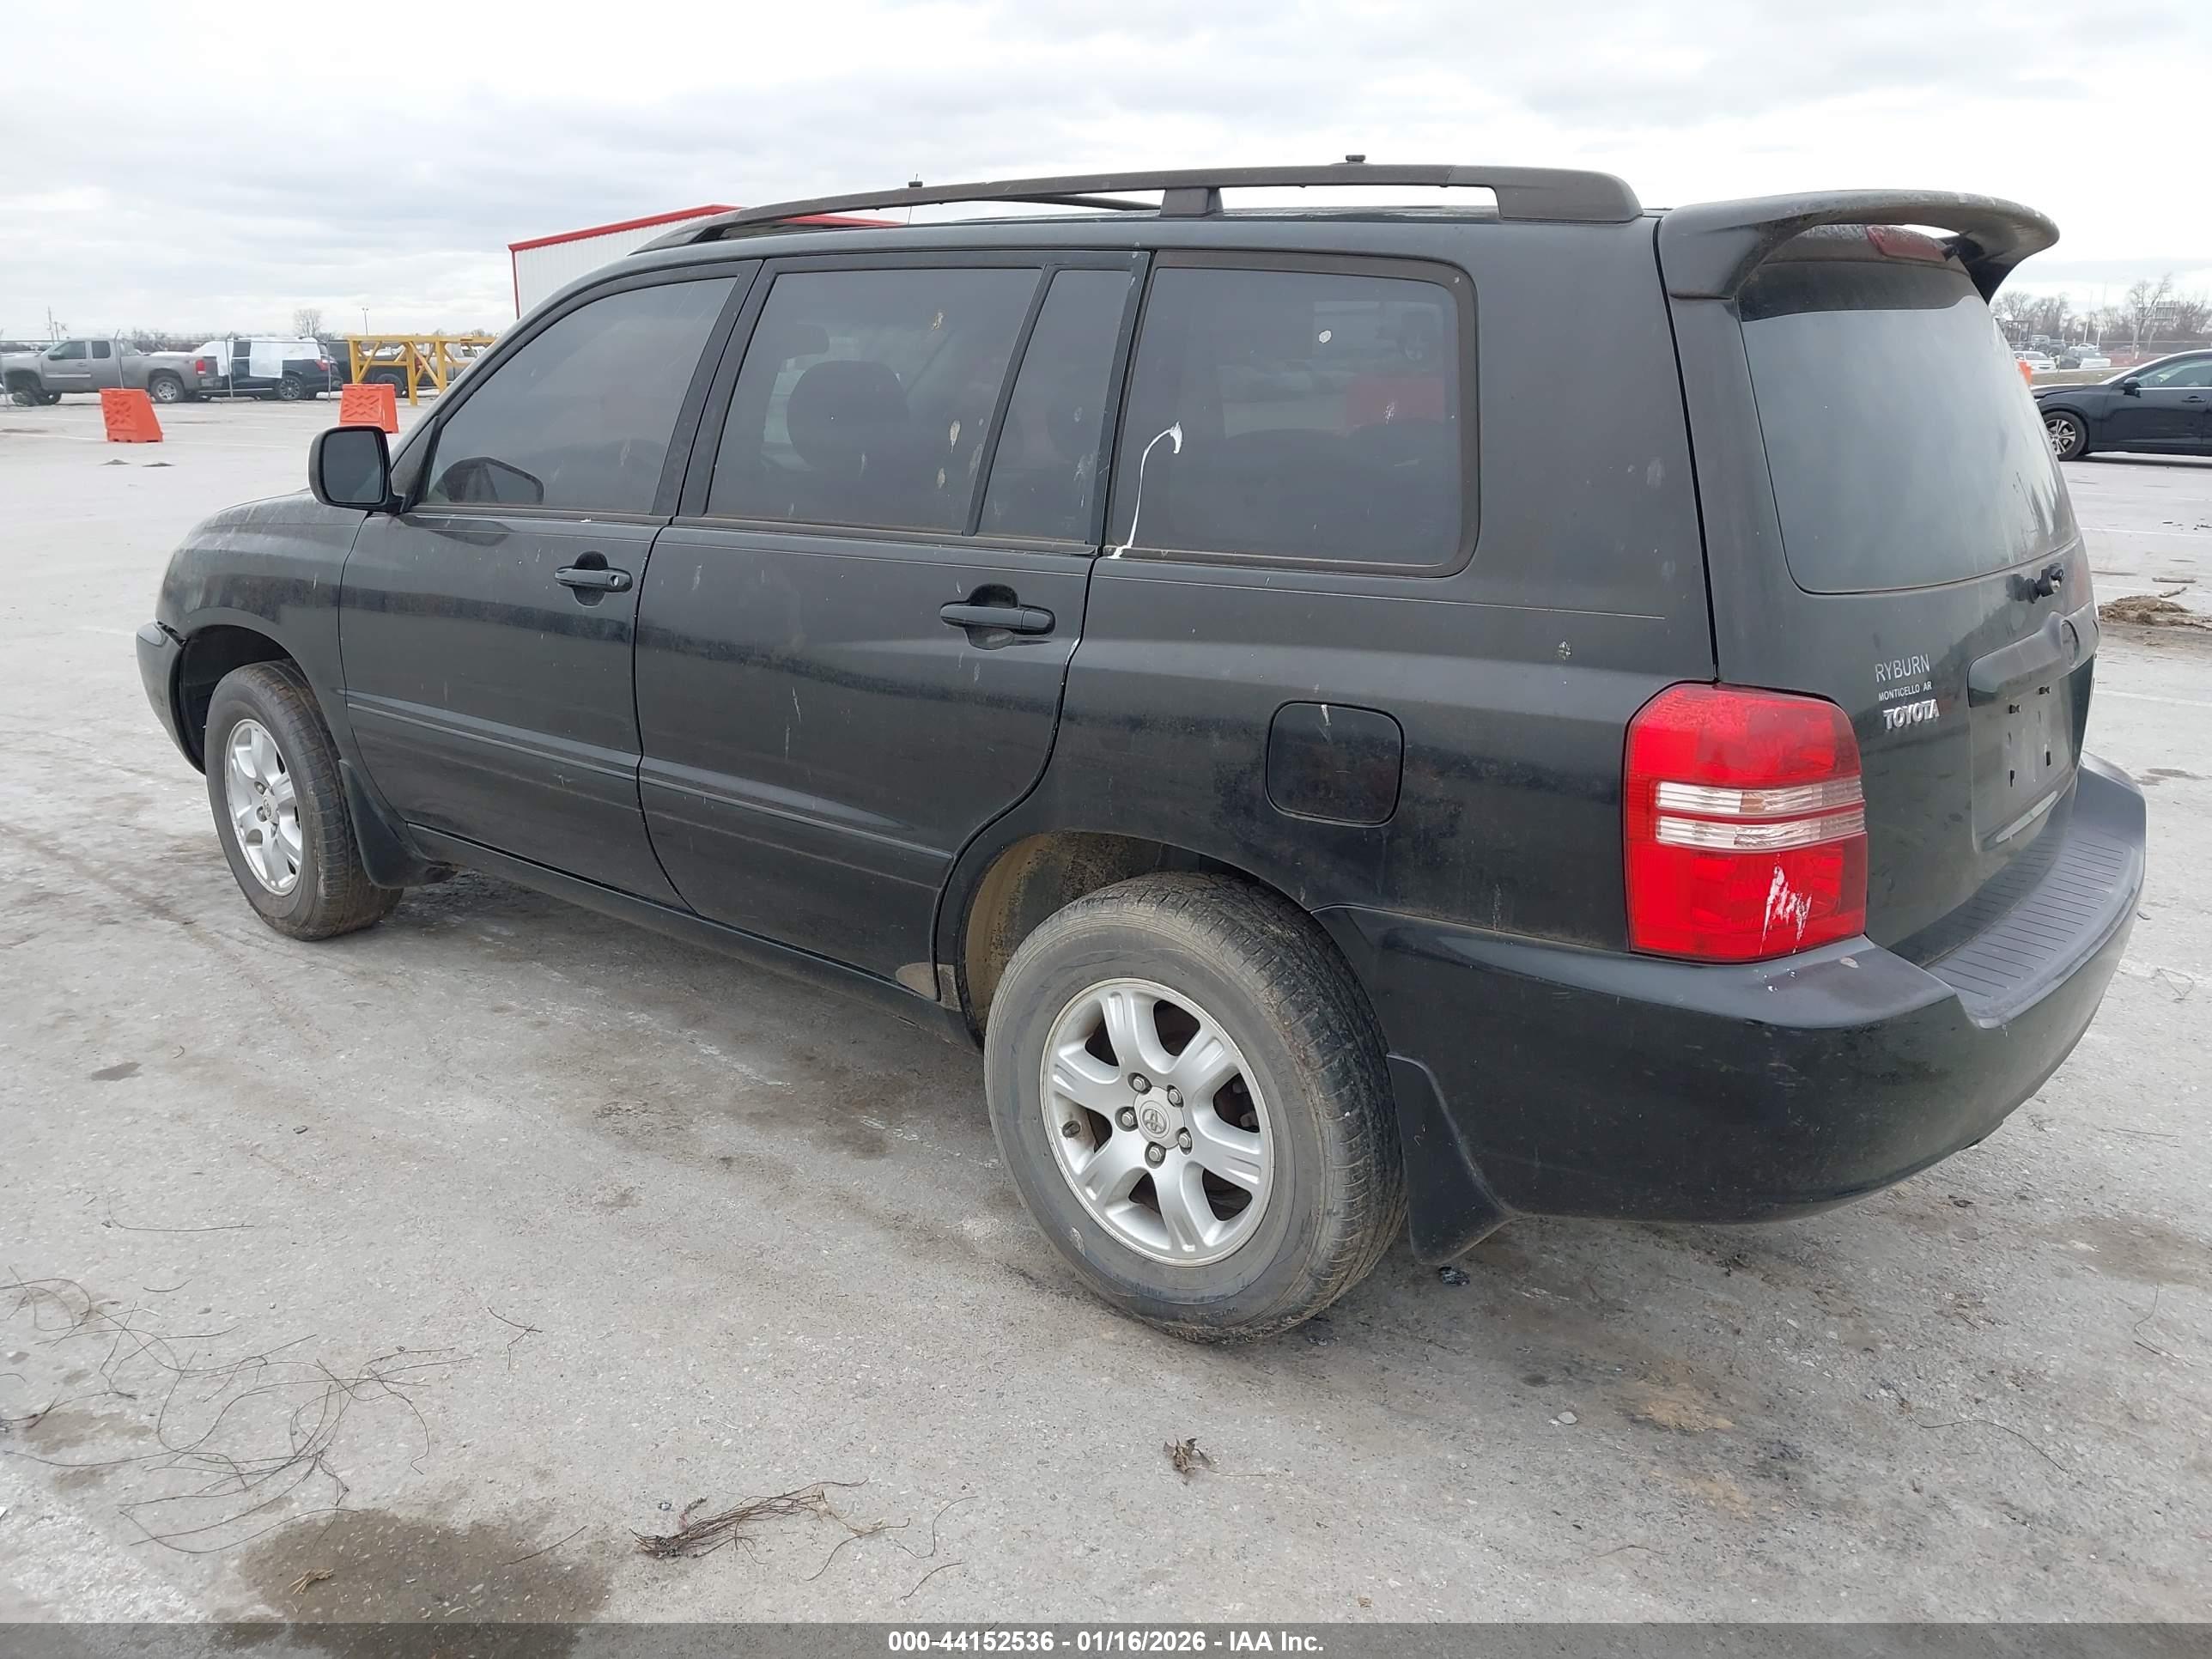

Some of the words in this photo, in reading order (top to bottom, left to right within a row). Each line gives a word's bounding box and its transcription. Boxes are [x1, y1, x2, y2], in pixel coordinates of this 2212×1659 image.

[1875, 653, 1930, 683] RYBURN
[1878, 684, 1920, 702] MONTICELLO
[1923, 681, 1933, 692] AR
[1882, 698, 1941, 730] TOYOTA
